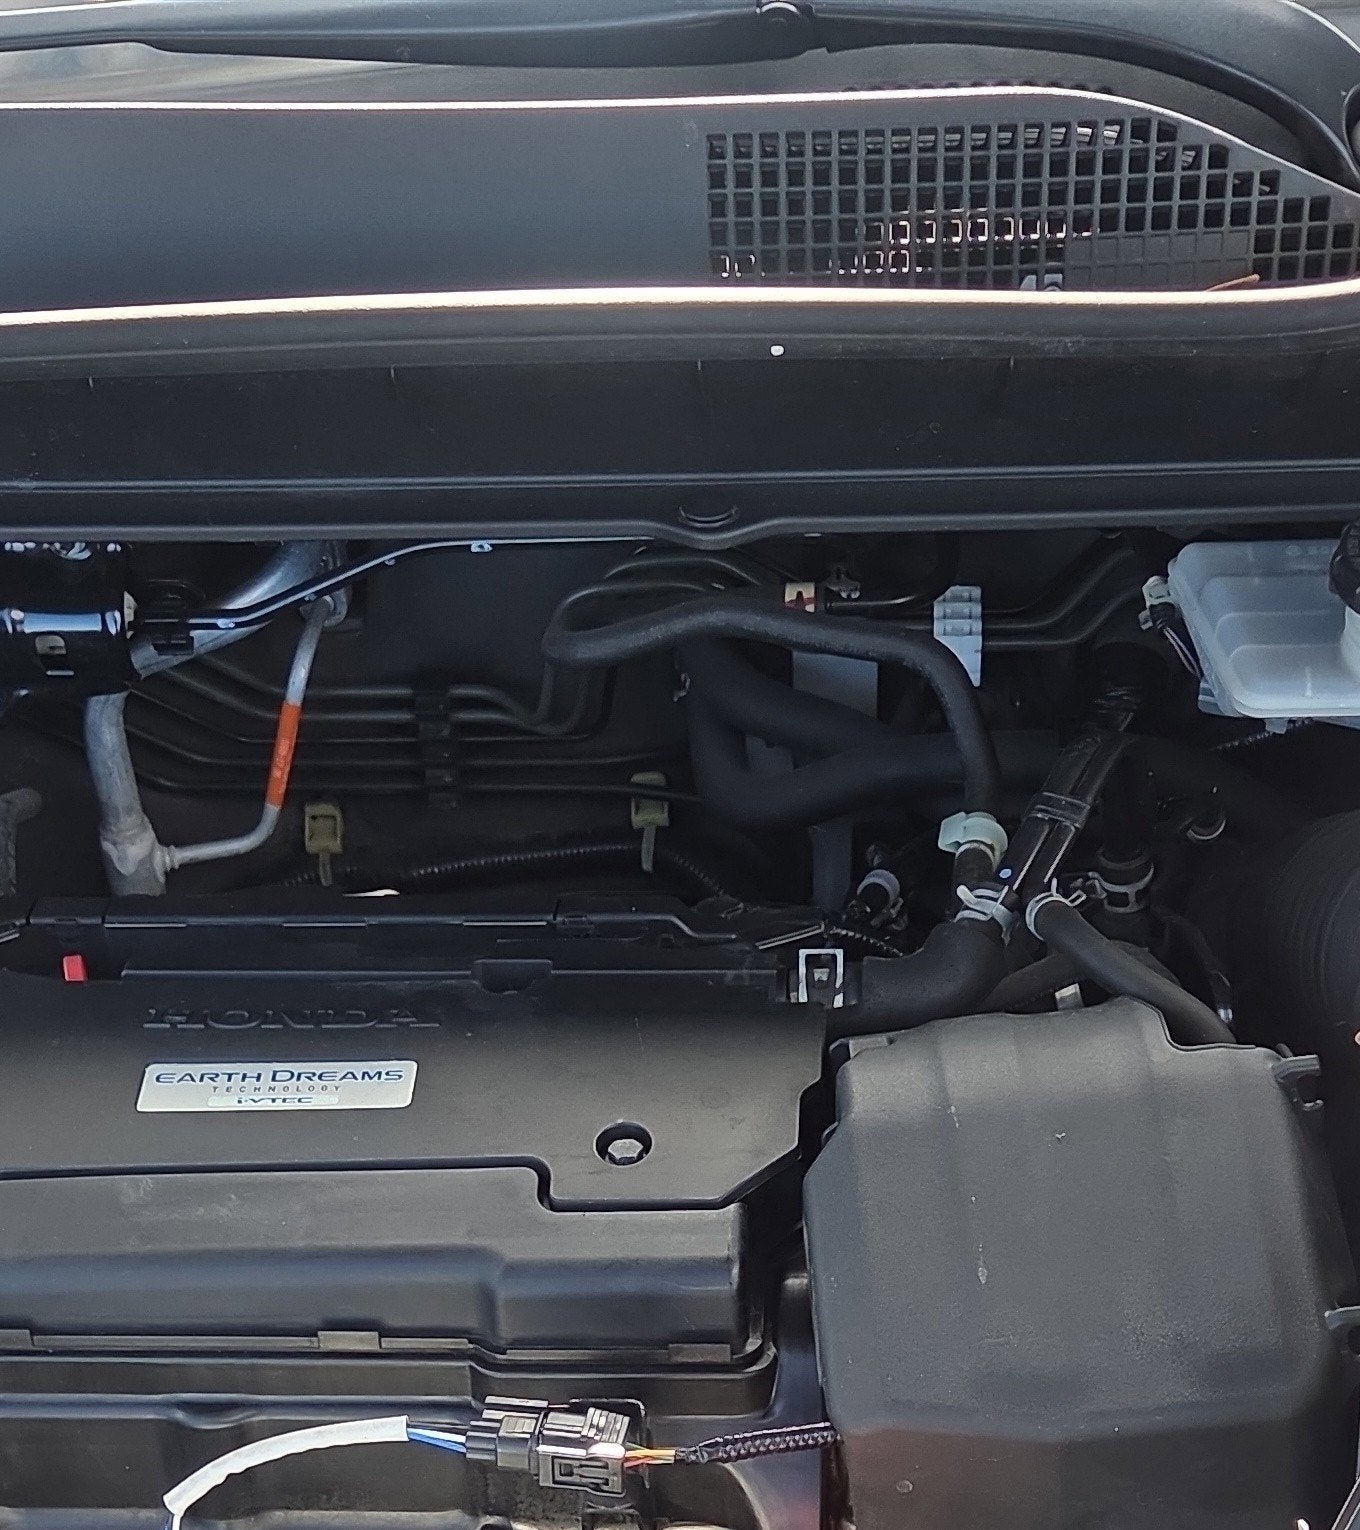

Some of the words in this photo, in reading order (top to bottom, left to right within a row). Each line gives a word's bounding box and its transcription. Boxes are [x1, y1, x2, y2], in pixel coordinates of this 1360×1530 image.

[142, 1009, 440, 1028] HONDA
[154, 1071, 262, 1084] EARTH
[271, 1069, 404, 1083] DREAMS
[211, 1085, 342, 1093] TECHNOLOGY
